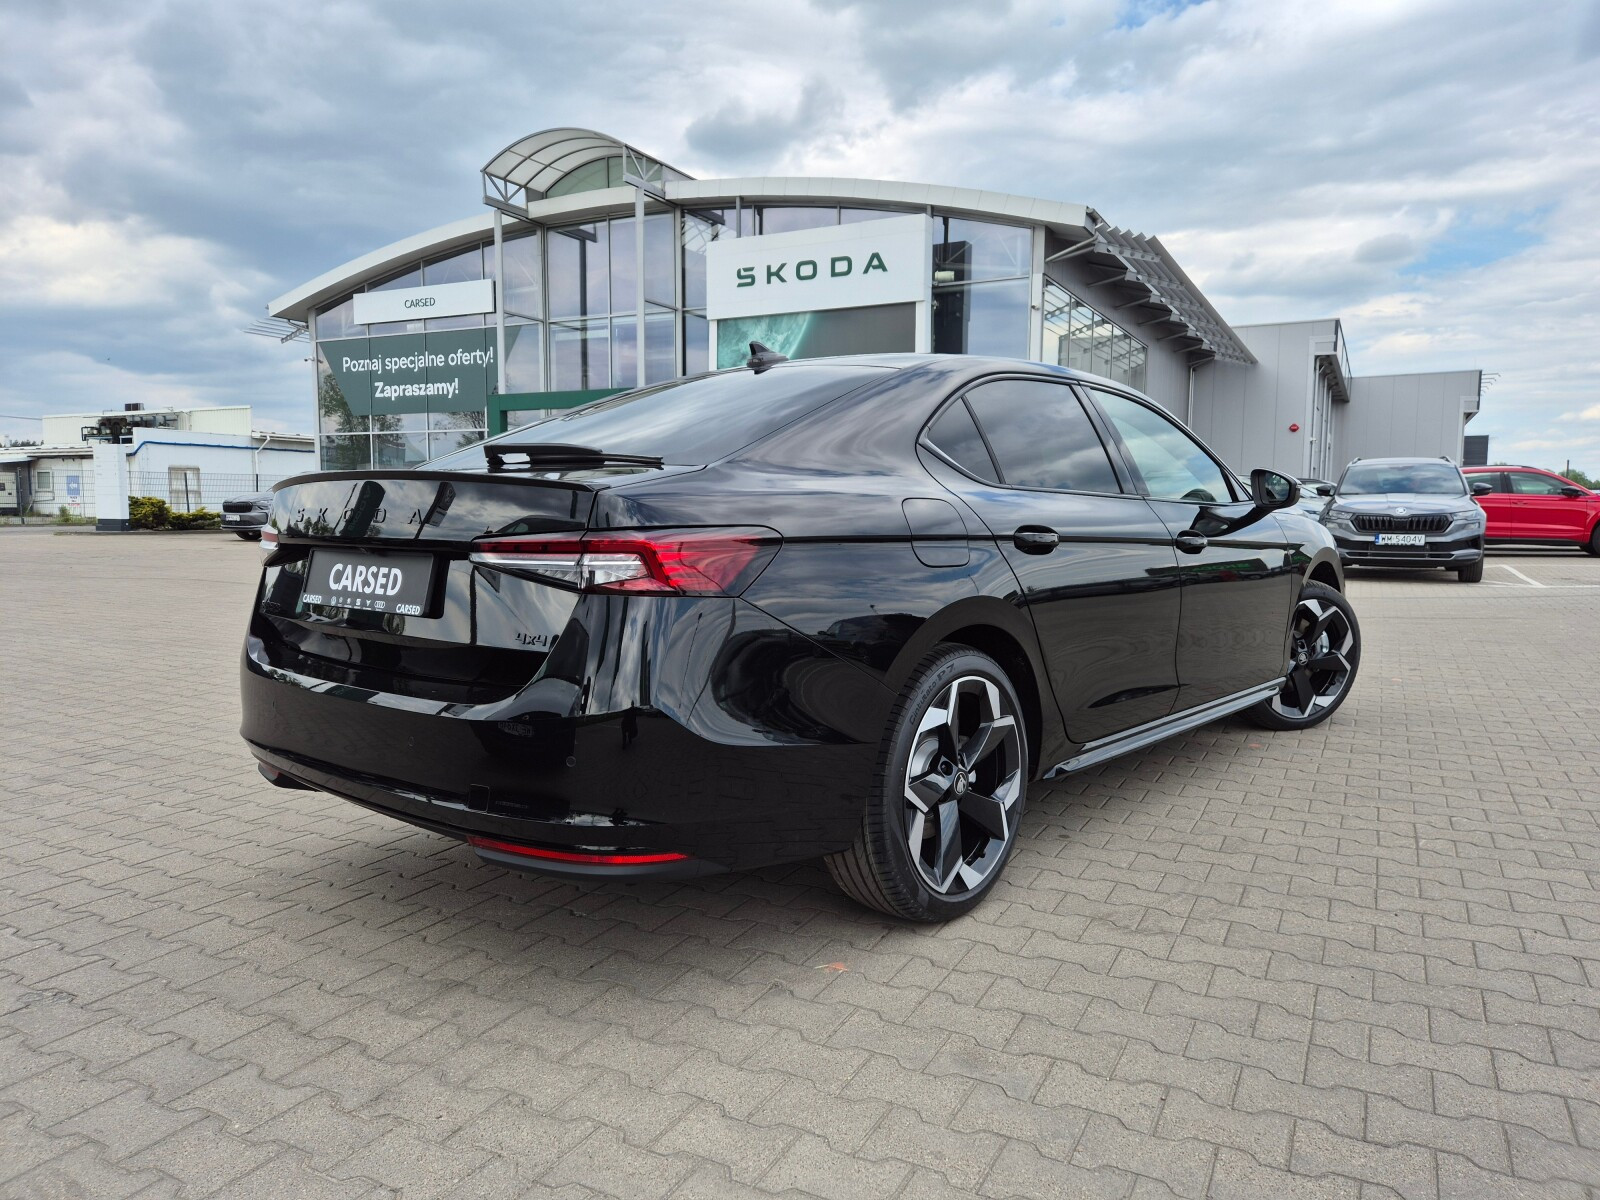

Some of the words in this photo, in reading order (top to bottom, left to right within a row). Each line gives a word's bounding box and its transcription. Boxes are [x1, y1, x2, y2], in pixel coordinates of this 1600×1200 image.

[404, 297, 436, 309] CARSED
[342, 355, 382, 374] Poznaj
[385, 351, 445, 374] specjalne
[448, 346, 494, 368] oferty!
[374, 378, 460, 401] Zapraszamy!
[328, 562, 403, 597] CARSED
[302, 593, 322, 605] CARSED
[395, 603, 421, 615] CARSED
[514, 632, 548, 647] 4x4
